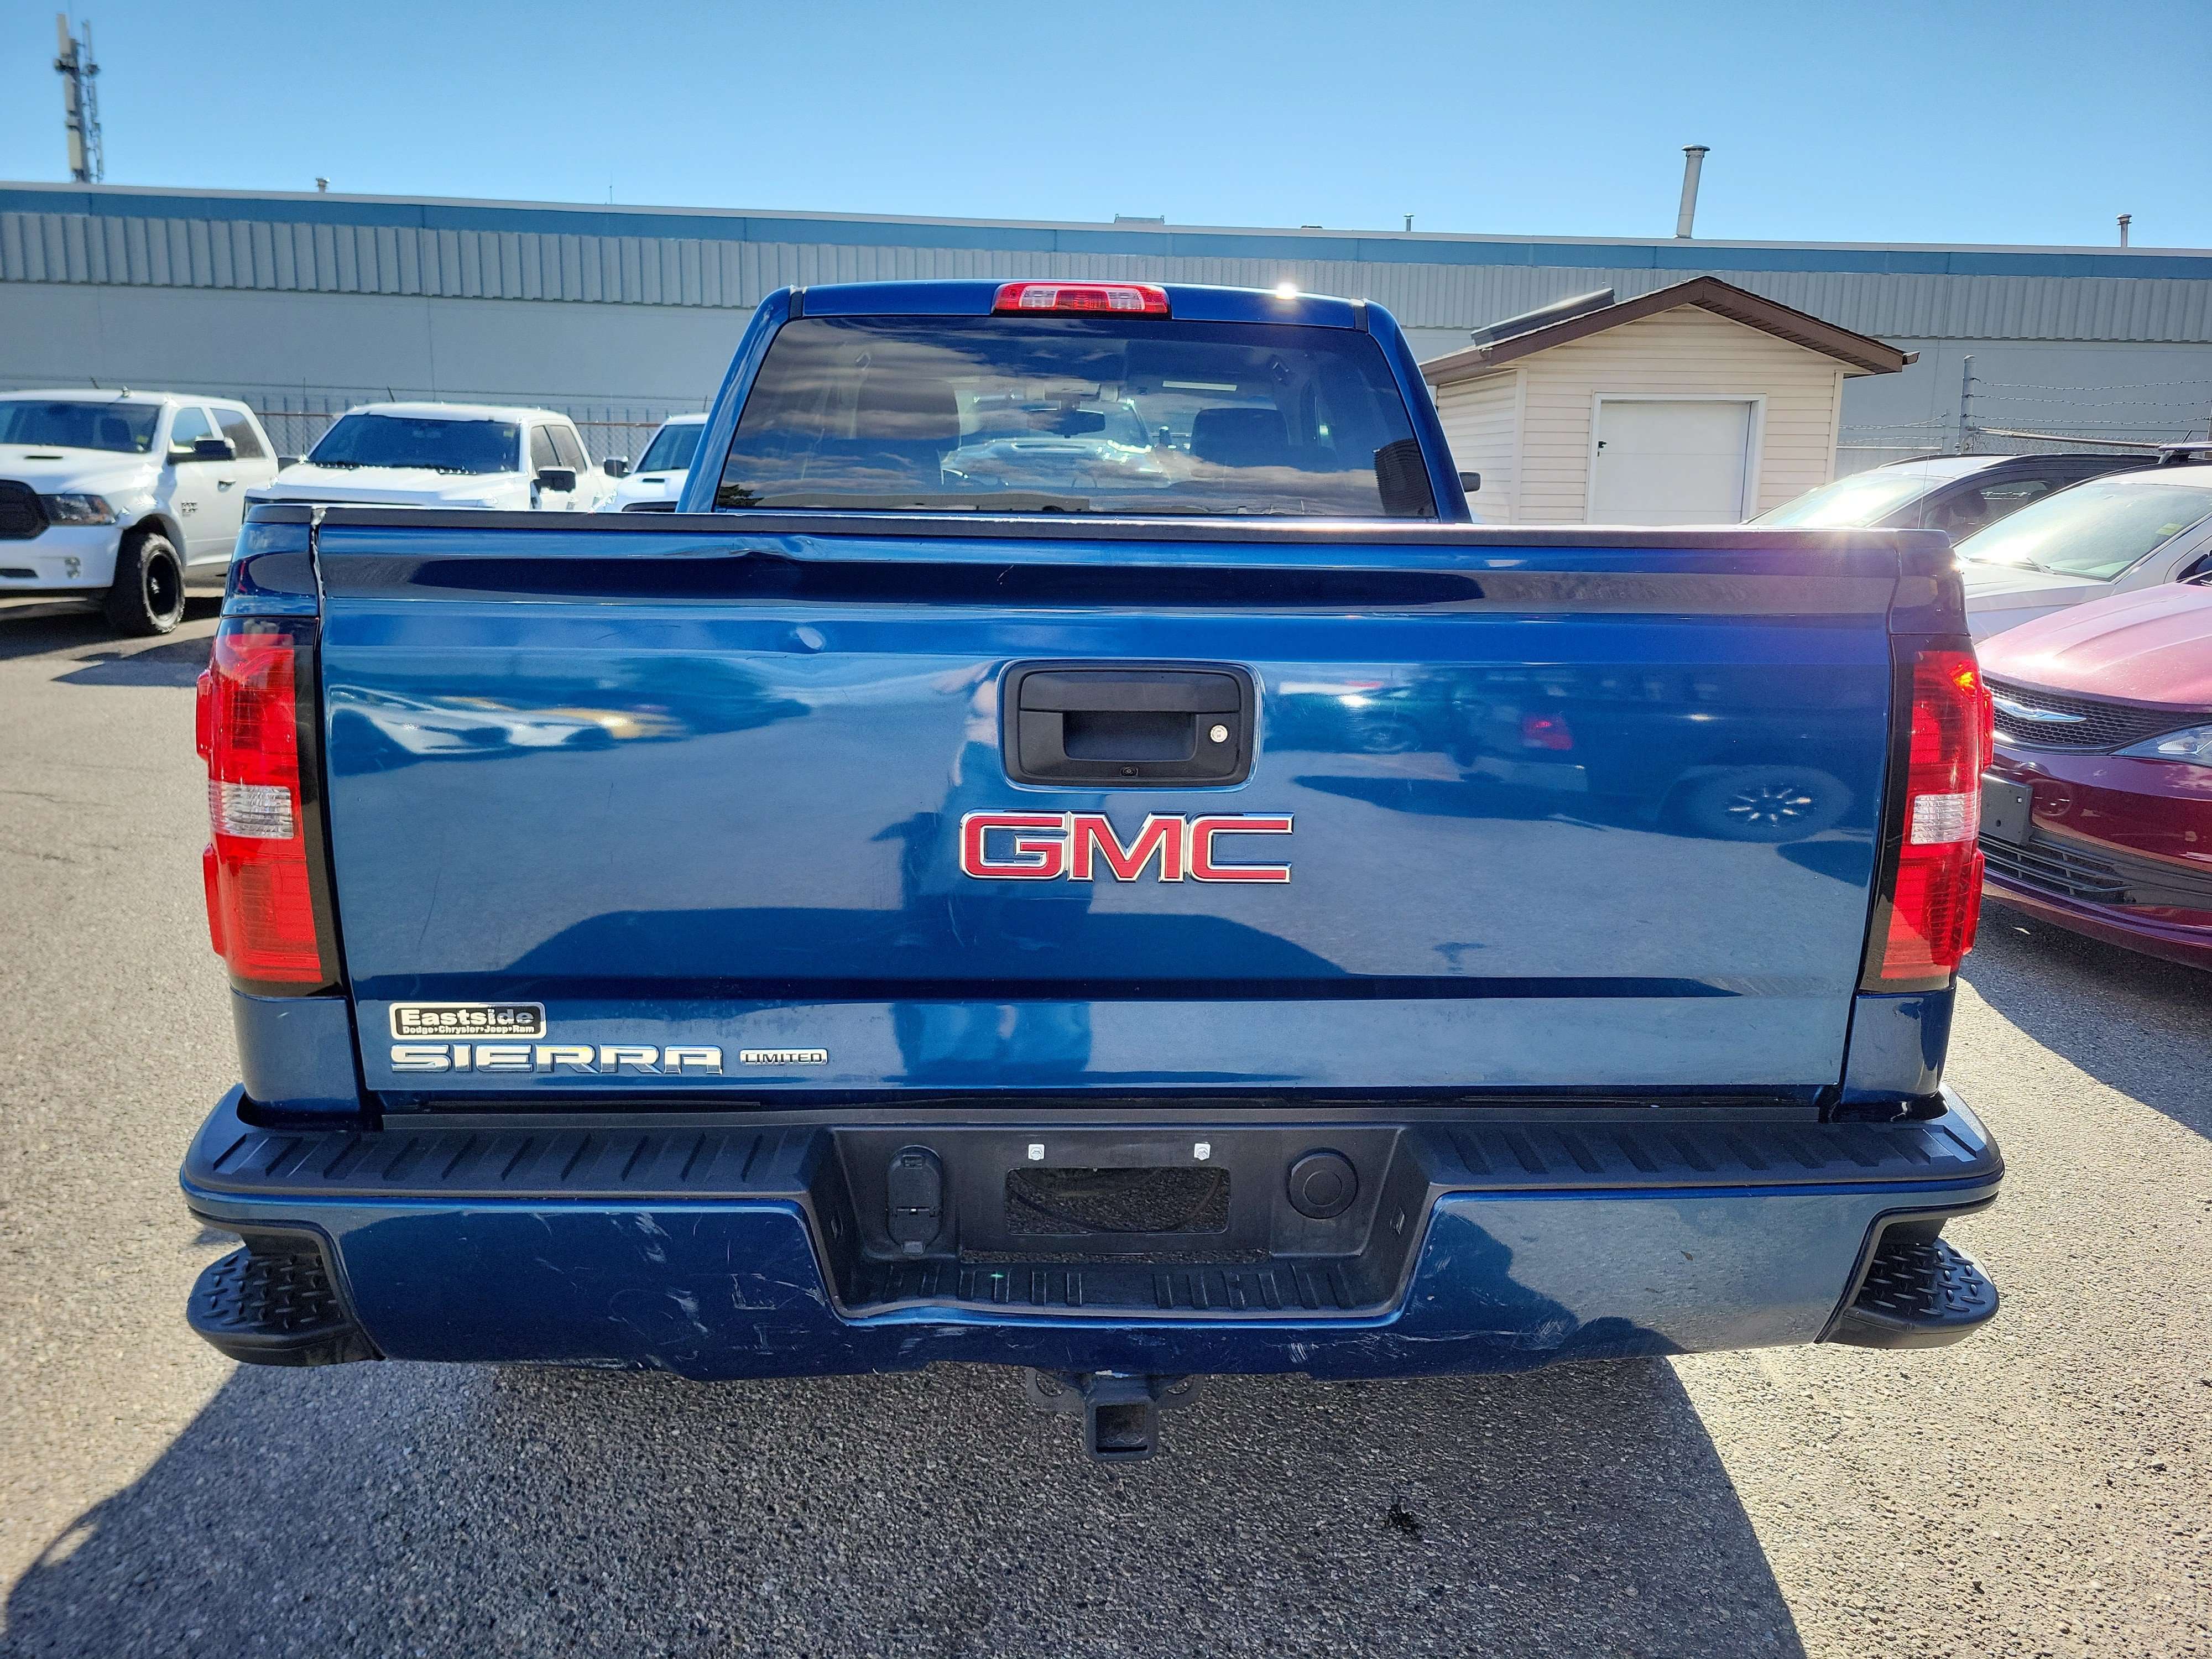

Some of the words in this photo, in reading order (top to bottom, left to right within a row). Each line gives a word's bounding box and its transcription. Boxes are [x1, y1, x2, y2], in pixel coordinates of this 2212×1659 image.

[959, 810, 1294, 883] GMC
[400, 1009, 534, 1026] Eastside
[390, 1044, 723, 1074] SIERRA
[745, 1052, 822, 1063] LIMITED
